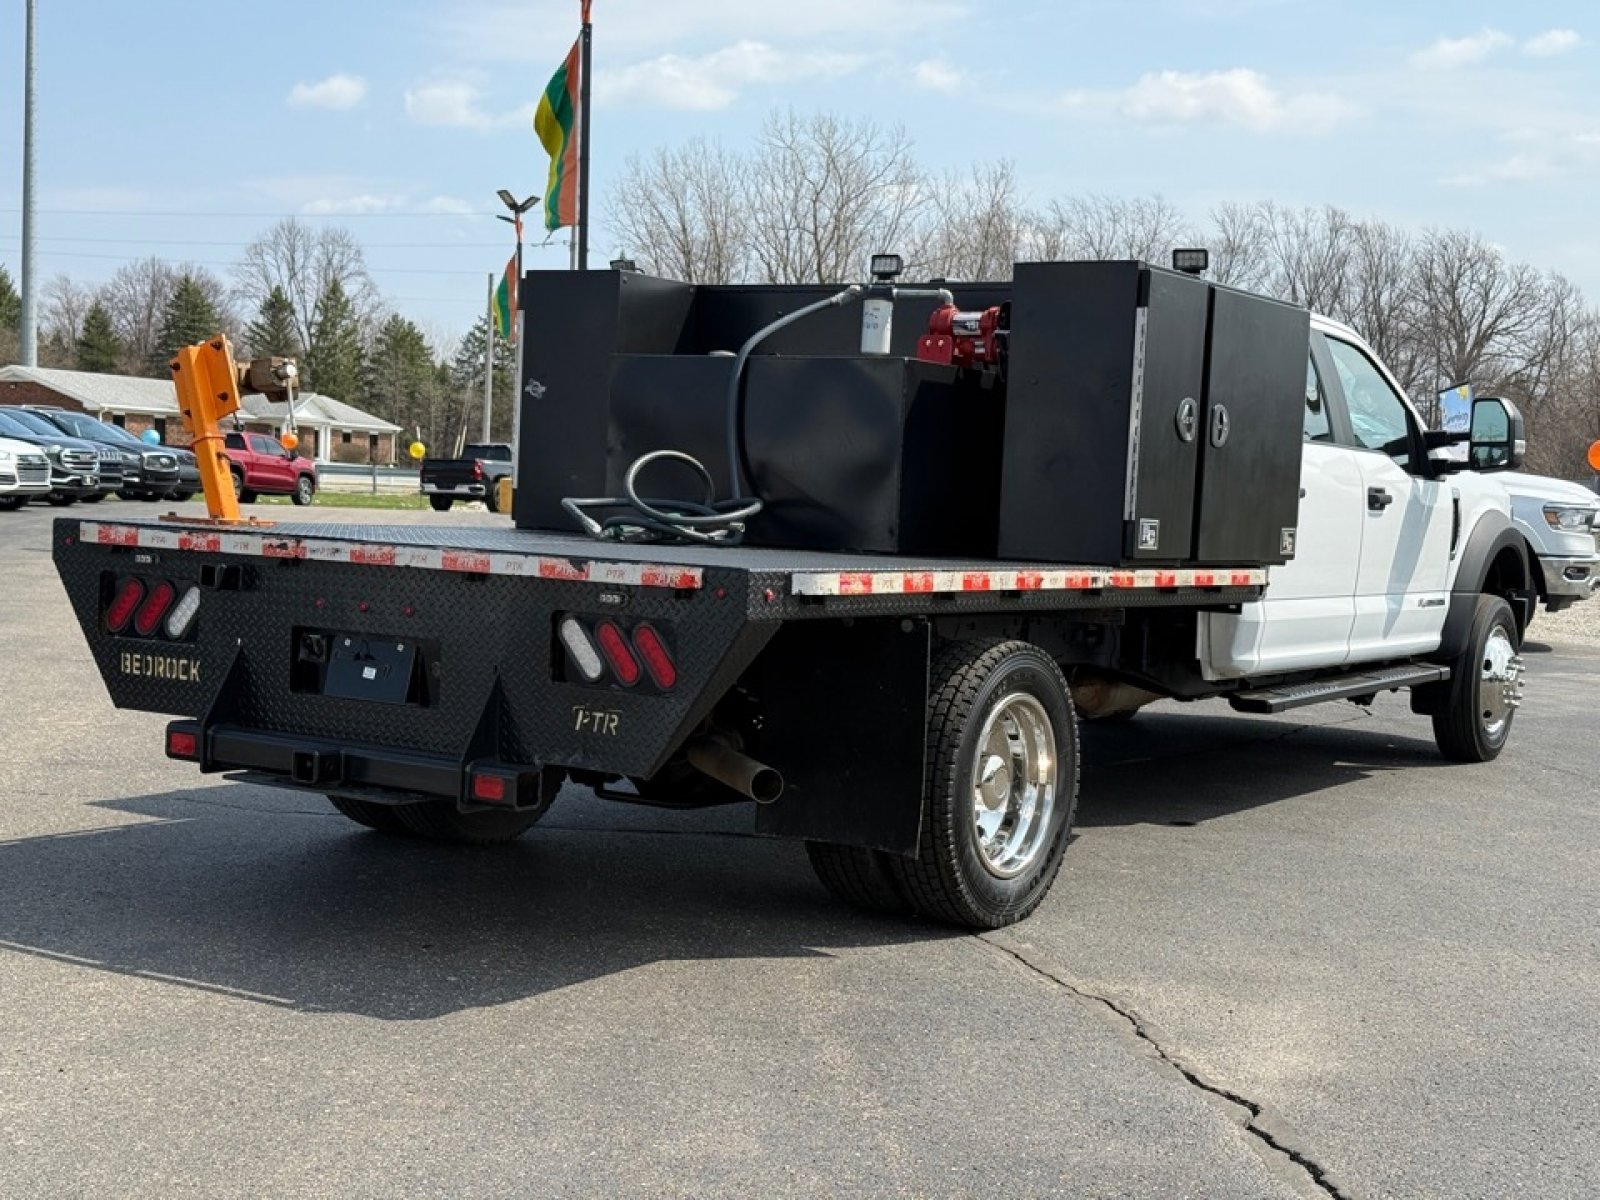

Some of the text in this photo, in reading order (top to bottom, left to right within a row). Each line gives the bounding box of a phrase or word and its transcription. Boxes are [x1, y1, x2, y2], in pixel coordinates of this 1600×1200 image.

[606, 569, 625, 579] PTR
[121, 652, 201, 682] BEDROCK
[574, 708, 619, 736] PTR
